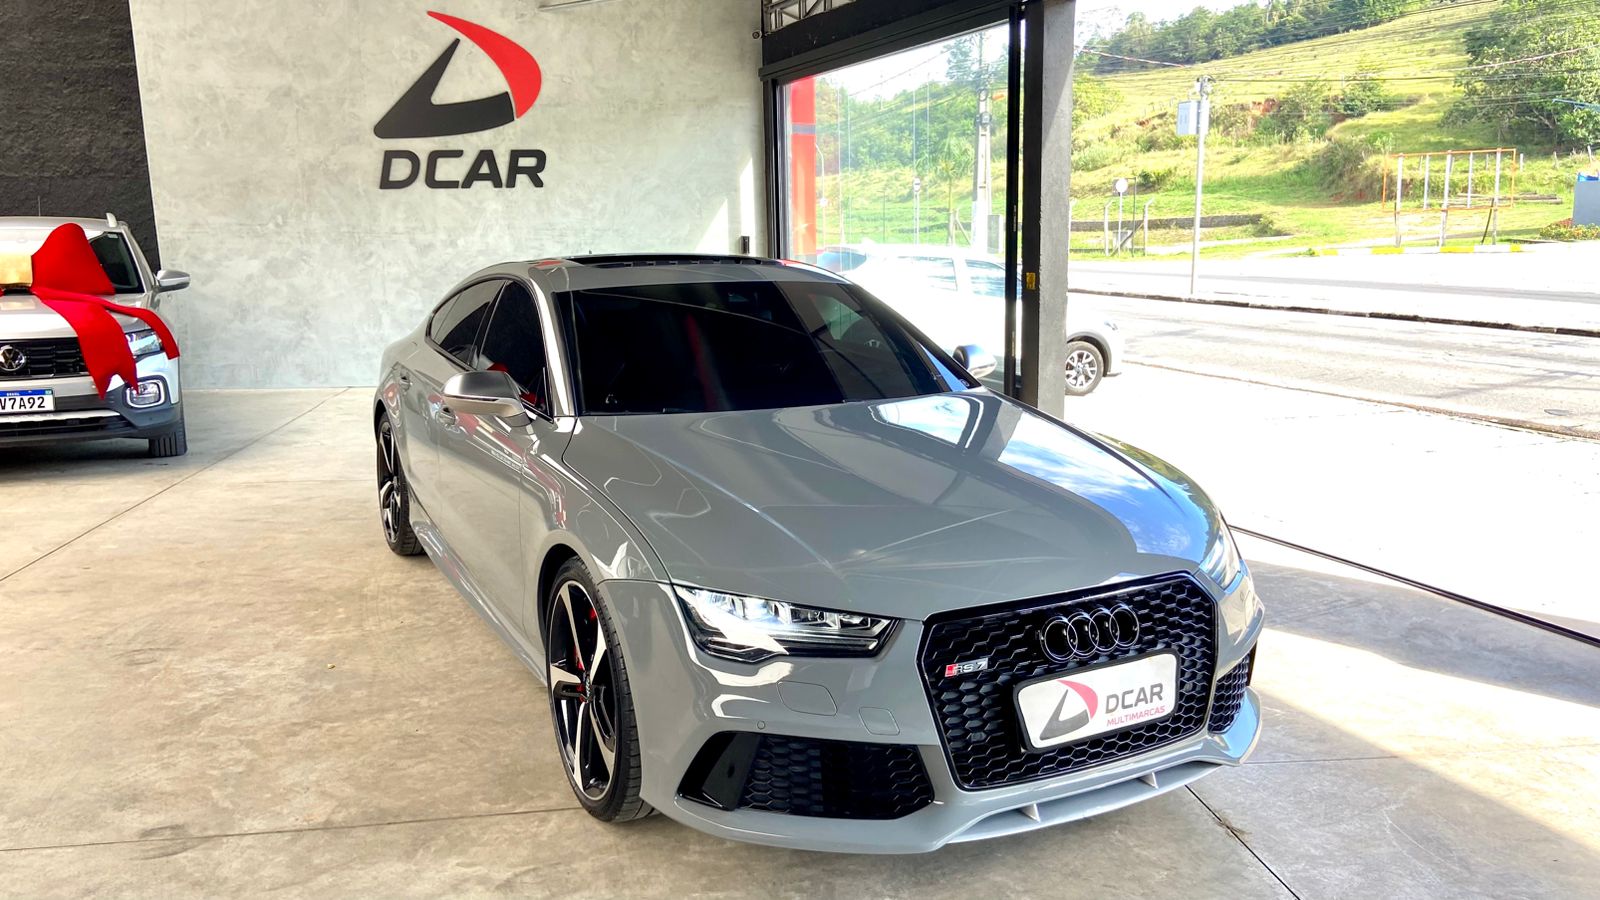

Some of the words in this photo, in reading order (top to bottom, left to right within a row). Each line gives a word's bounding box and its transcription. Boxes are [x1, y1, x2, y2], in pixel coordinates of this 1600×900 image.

[379, 149, 547, 190] DCAR
[1105, 683, 1163, 714] DCAR
[1106, 705, 1166, 727] MULTIMARCAS
